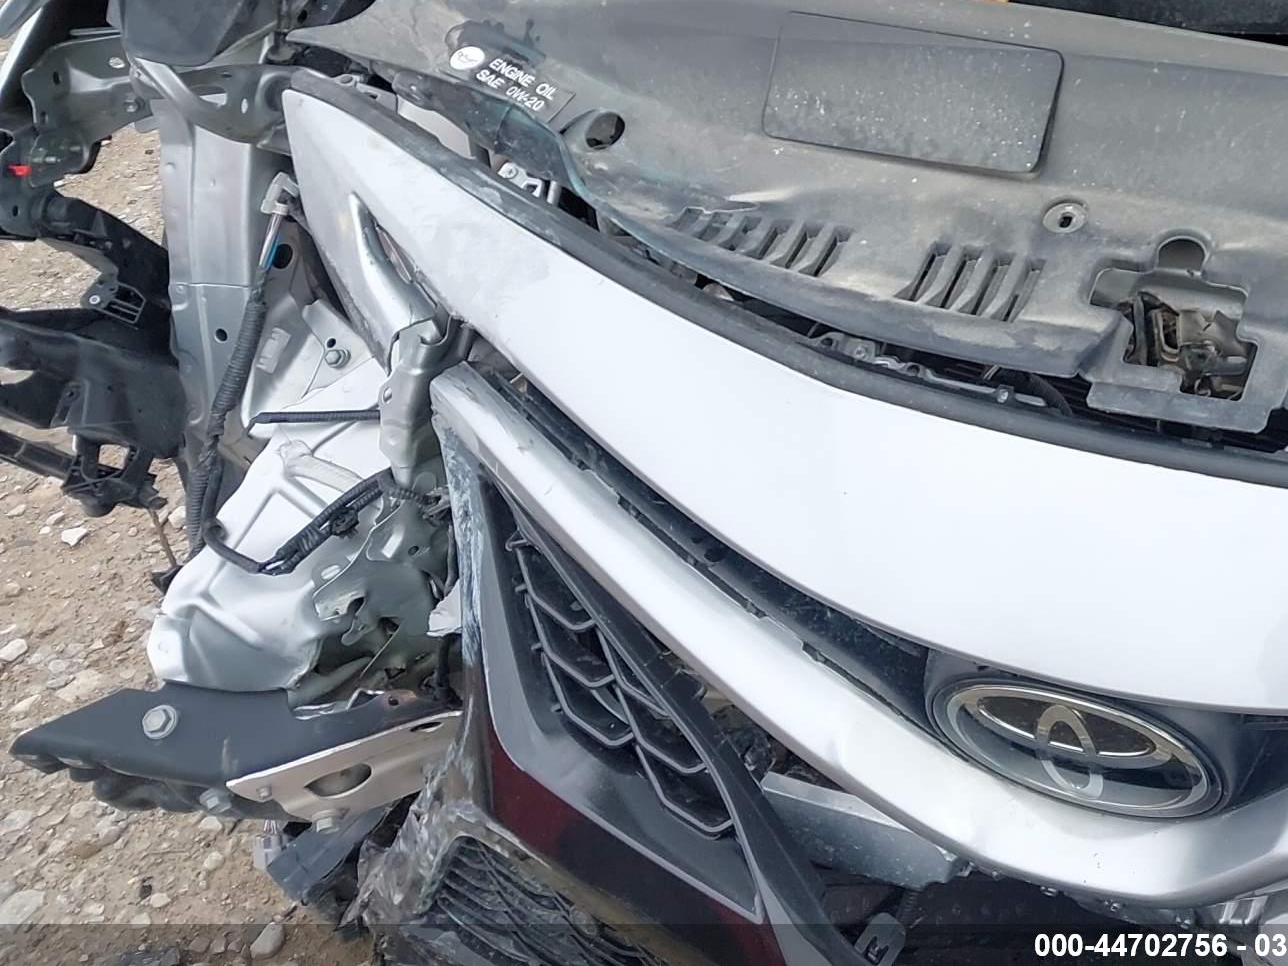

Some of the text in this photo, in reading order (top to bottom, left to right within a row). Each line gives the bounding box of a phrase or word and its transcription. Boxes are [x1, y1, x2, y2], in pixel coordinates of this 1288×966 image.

[475, 68, 545, 111] SAE 0W-20
[488, 57, 557, 101] ENGINE OIL
